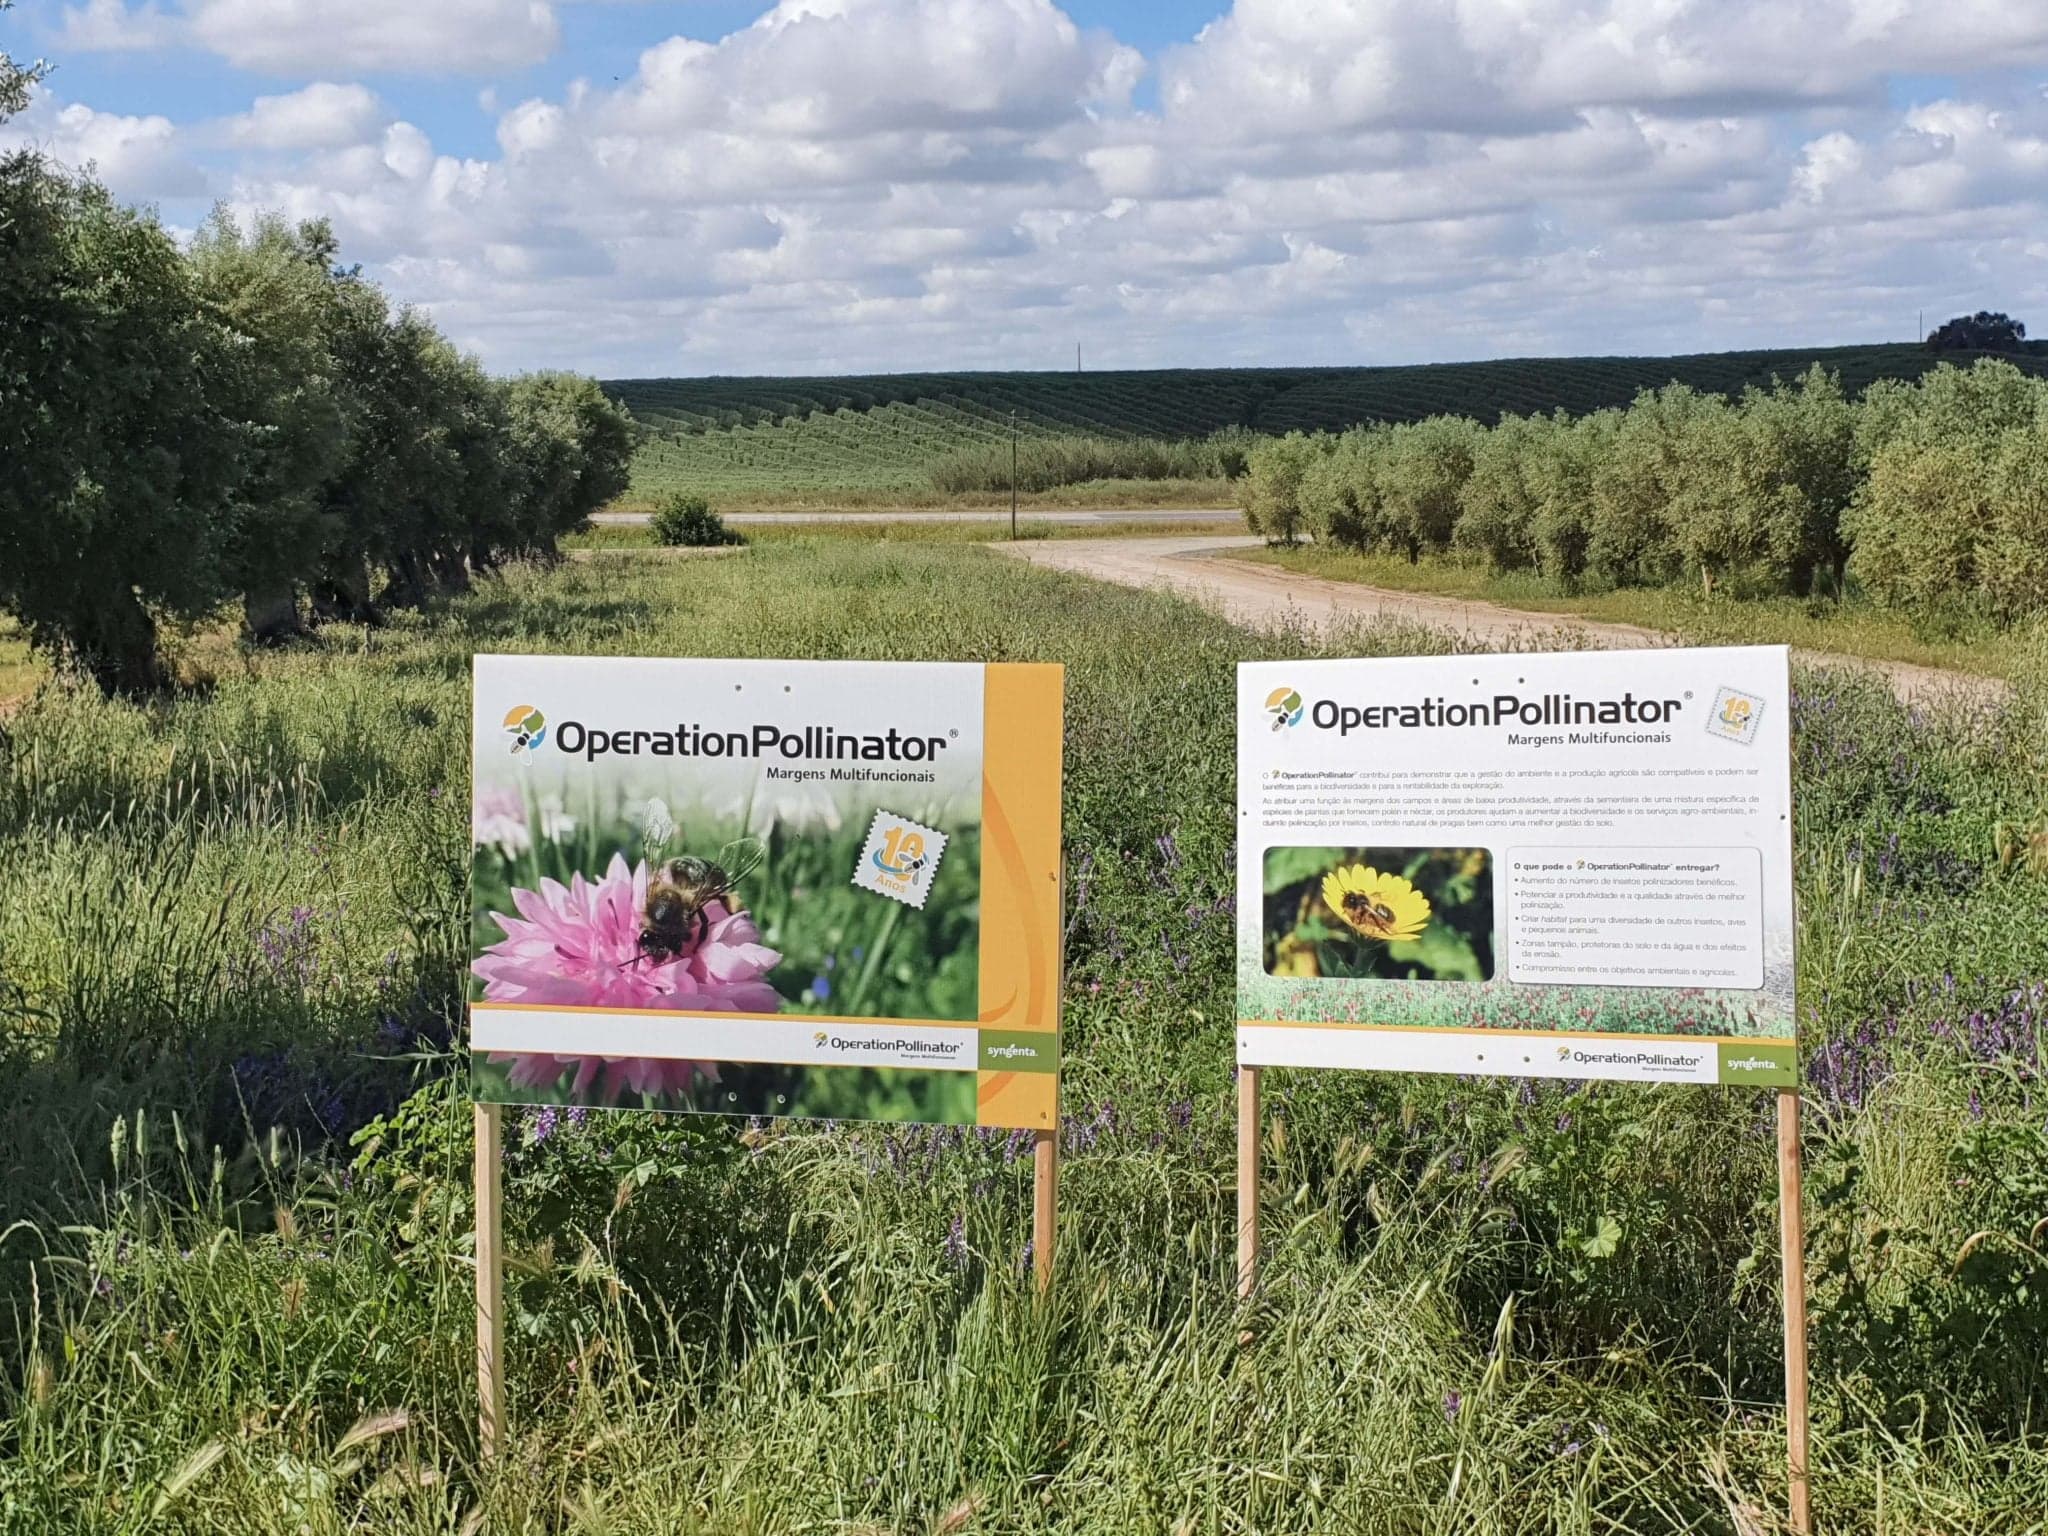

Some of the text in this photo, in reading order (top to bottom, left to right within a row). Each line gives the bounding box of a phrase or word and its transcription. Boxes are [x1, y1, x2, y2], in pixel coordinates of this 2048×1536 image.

[1508, 731, 1672, 747] Margens Multifuncionais
[767, 767, 935, 782] Margens Multifuncionais
[1541, 862, 1564, 871] pode
[1586, 862, 1673, 872] OperationPollinator
[1674, 863, 1720, 872] entregar?
[875, 874, 907, 893] Anos
